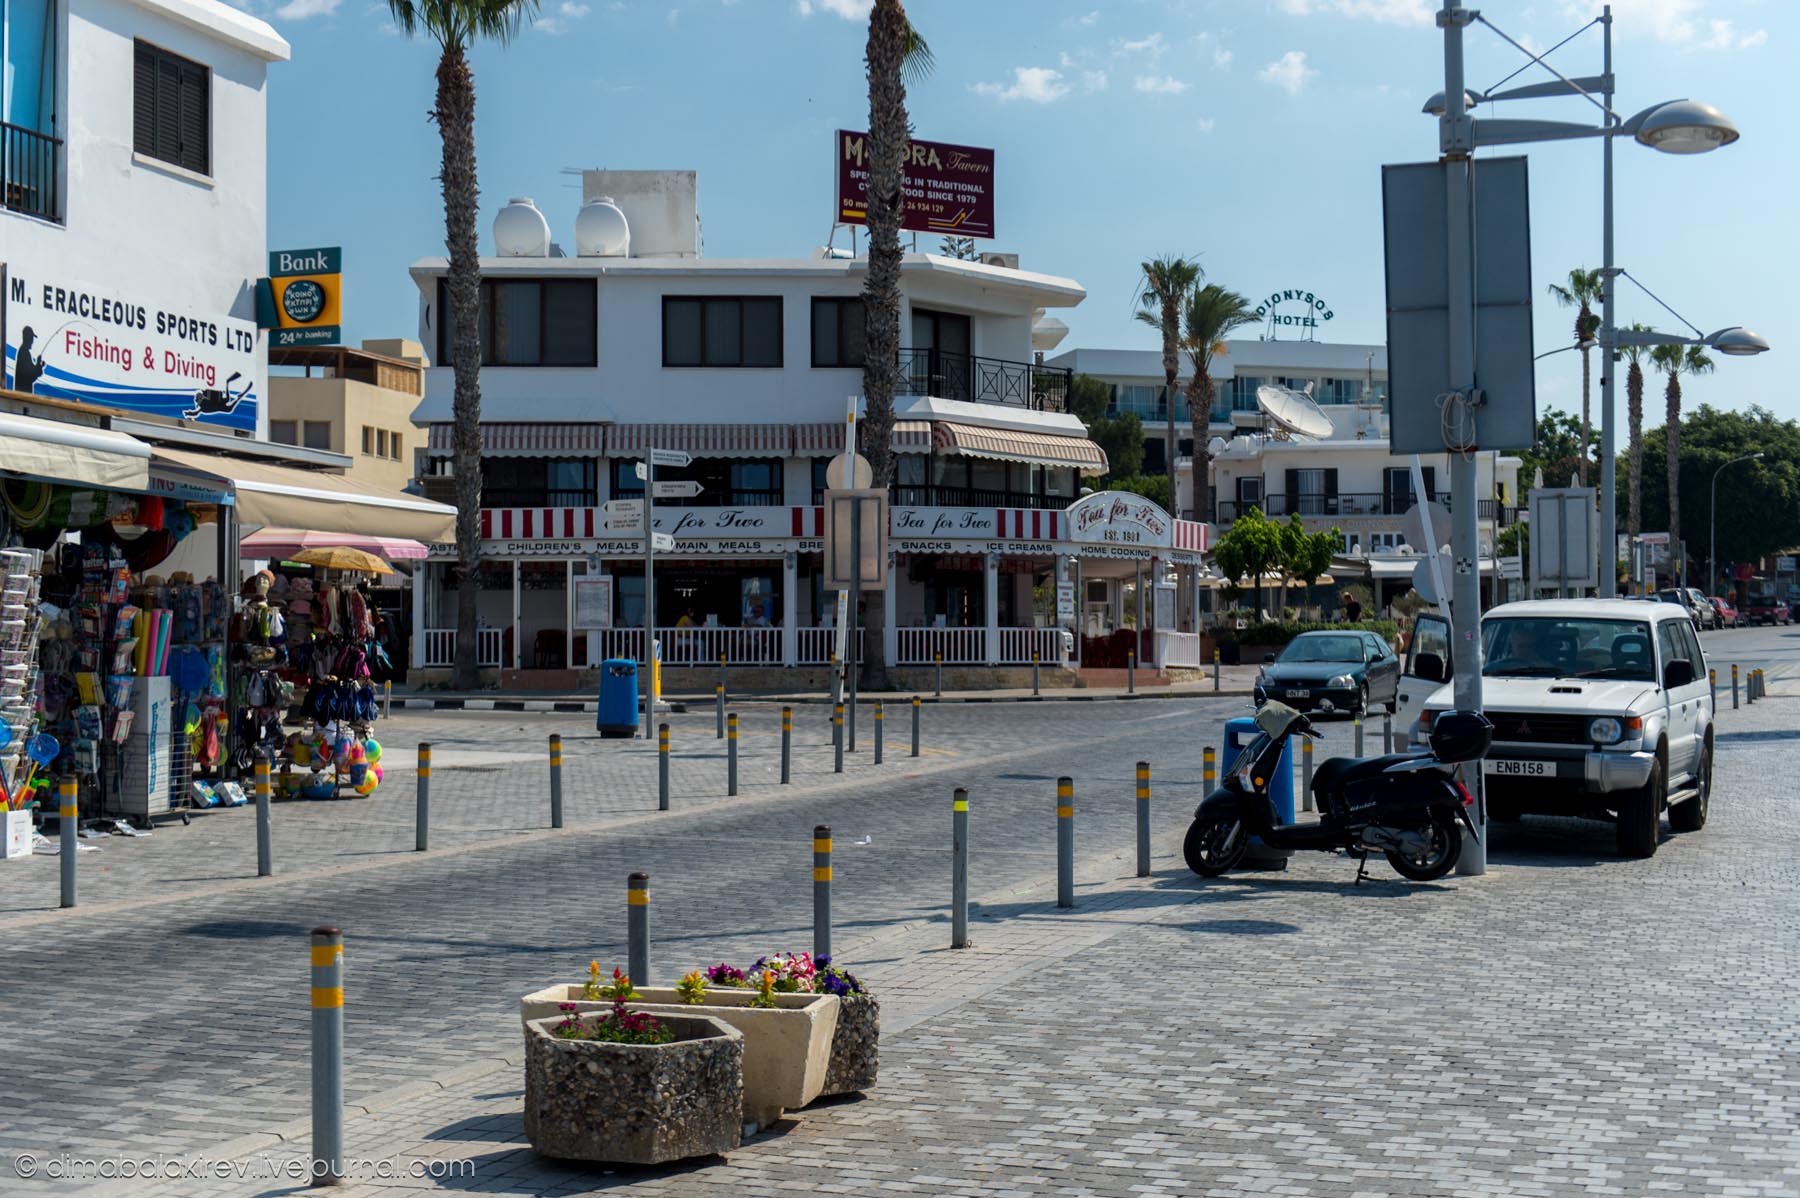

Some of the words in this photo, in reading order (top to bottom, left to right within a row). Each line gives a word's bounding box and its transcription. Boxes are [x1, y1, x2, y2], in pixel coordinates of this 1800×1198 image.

[946, 151, 990, 174] Tavern
[914, 178, 924, 187] IN
[927, 179, 985, 194] TRADITIONAL
[843, 198, 855, 207] 50
[927, 190, 954, 202] SINCE
[956, 194, 977, 204] 1979
[907, 201, 916, 210] 26
[917, 202, 930, 212] 934
[931, 204, 945, 213] 129
[279, 251, 328, 272] Bank
[1255, 289, 1334, 321] DIONYSOS
[11, 276, 32, 305] M.
[43, 284, 147, 331] ERACLEOUS
[156, 310, 218, 347] SPORTS
[226, 327, 253, 354] LTD
[1273, 314, 1319, 328] HOTEL
[279, 332, 295, 344] 24
[304, 330, 332, 339] banking
[65, 330, 132, 372] Fishing
[143, 346, 155, 370] &
[164, 350, 216, 387] Diving
[1108, 497, 1129, 525] for
[672, 511, 706, 535] for
[715, 510, 764, 528] Two
[896, 510, 925, 528] Tea
[931, 513, 953, 535] for
[959, 511, 992, 529] Two
[507, 542, 582, 551] CHILDREN'S
[597, 542, 639, 550] MEALS
[675, 542, 709, 550] MAIN
[718, 541, 761, 550] MEALS
[901, 541, 952, 550] SNACKS
[1008, 543, 1053, 552] CREAMS
[1081, 546, 1107, 554] HOME
[1111, 548, 1151, 558] COOKING
[1496, 761, 1544, 775] ENB158
